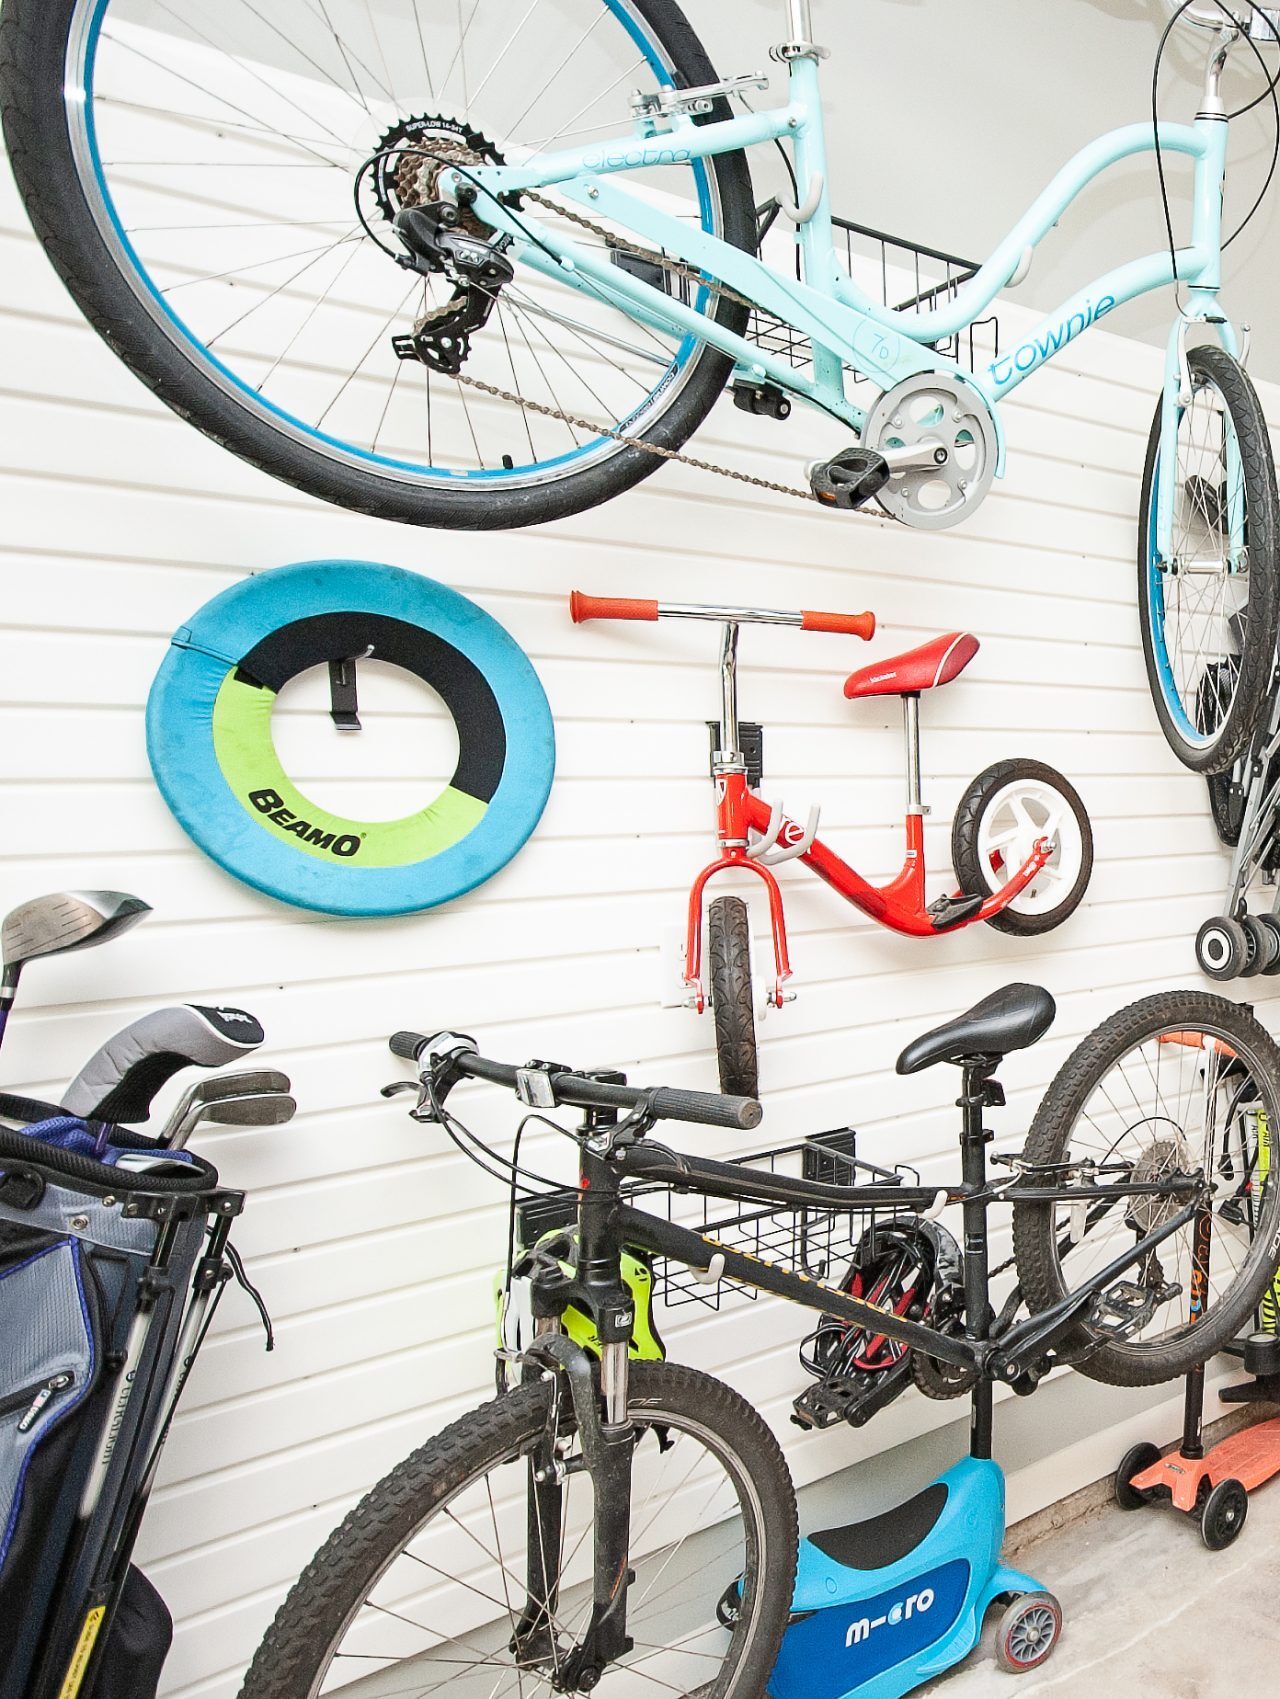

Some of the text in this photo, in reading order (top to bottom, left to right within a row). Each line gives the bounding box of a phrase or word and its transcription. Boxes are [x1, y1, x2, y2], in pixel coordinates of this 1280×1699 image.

[582, 148, 691, 168] electra
[988, 295, 1115, 385] townie
[248, 788, 361, 857] BEAMO
